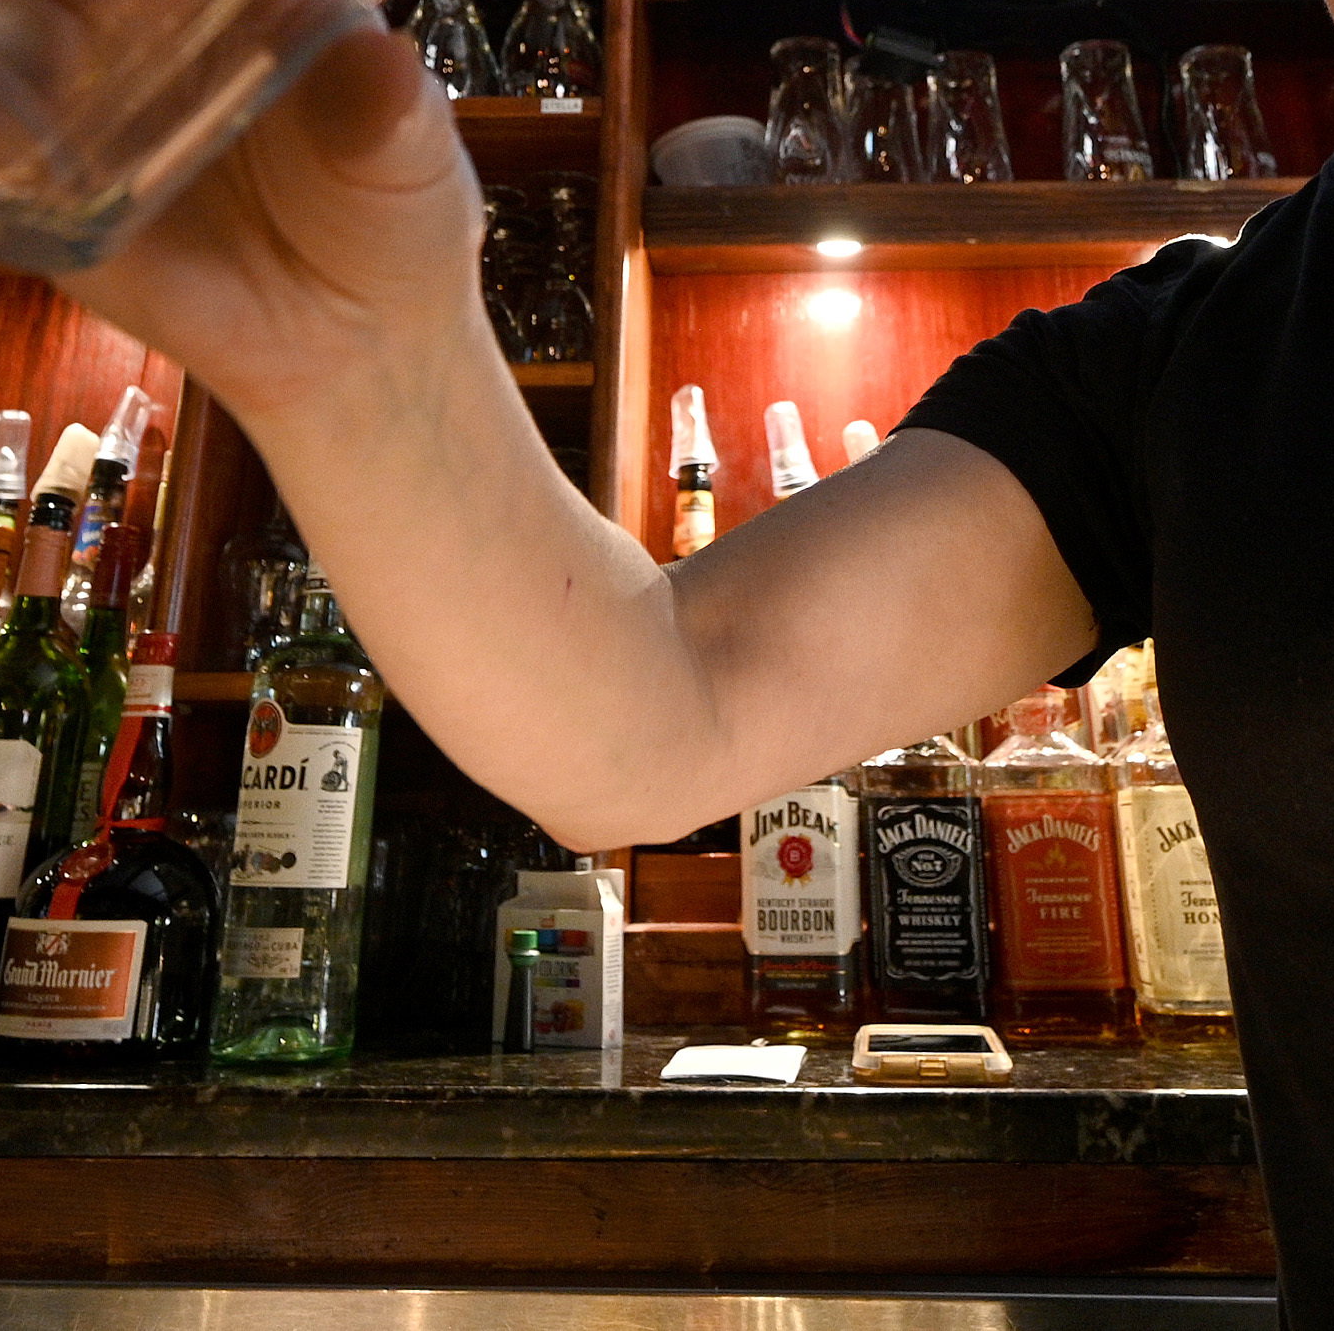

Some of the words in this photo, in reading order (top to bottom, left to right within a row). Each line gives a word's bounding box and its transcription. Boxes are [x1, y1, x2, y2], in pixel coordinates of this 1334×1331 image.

[243, 757, 310, 791] CARDÍ
[750, 809, 784, 846] JIM
[787, 801, 838, 843] BEAM
[876, 820, 916, 854] JACK
[913, 813, 975, 854] DANIEL'S
[1005, 821, 1045, 854] JACK
[1041, 814, 1102, 853] DANIEL'S
[1156, 820, 1197, 853] JACK
[1040, 906, 1083, 919] FIRE
[1180, 890, 1217, 908] Tenn
[757, 909, 835, 932] BOURBON
[897, 914, 962, 927] WHISKEY
[36, 959, 116, 990] Marnier
